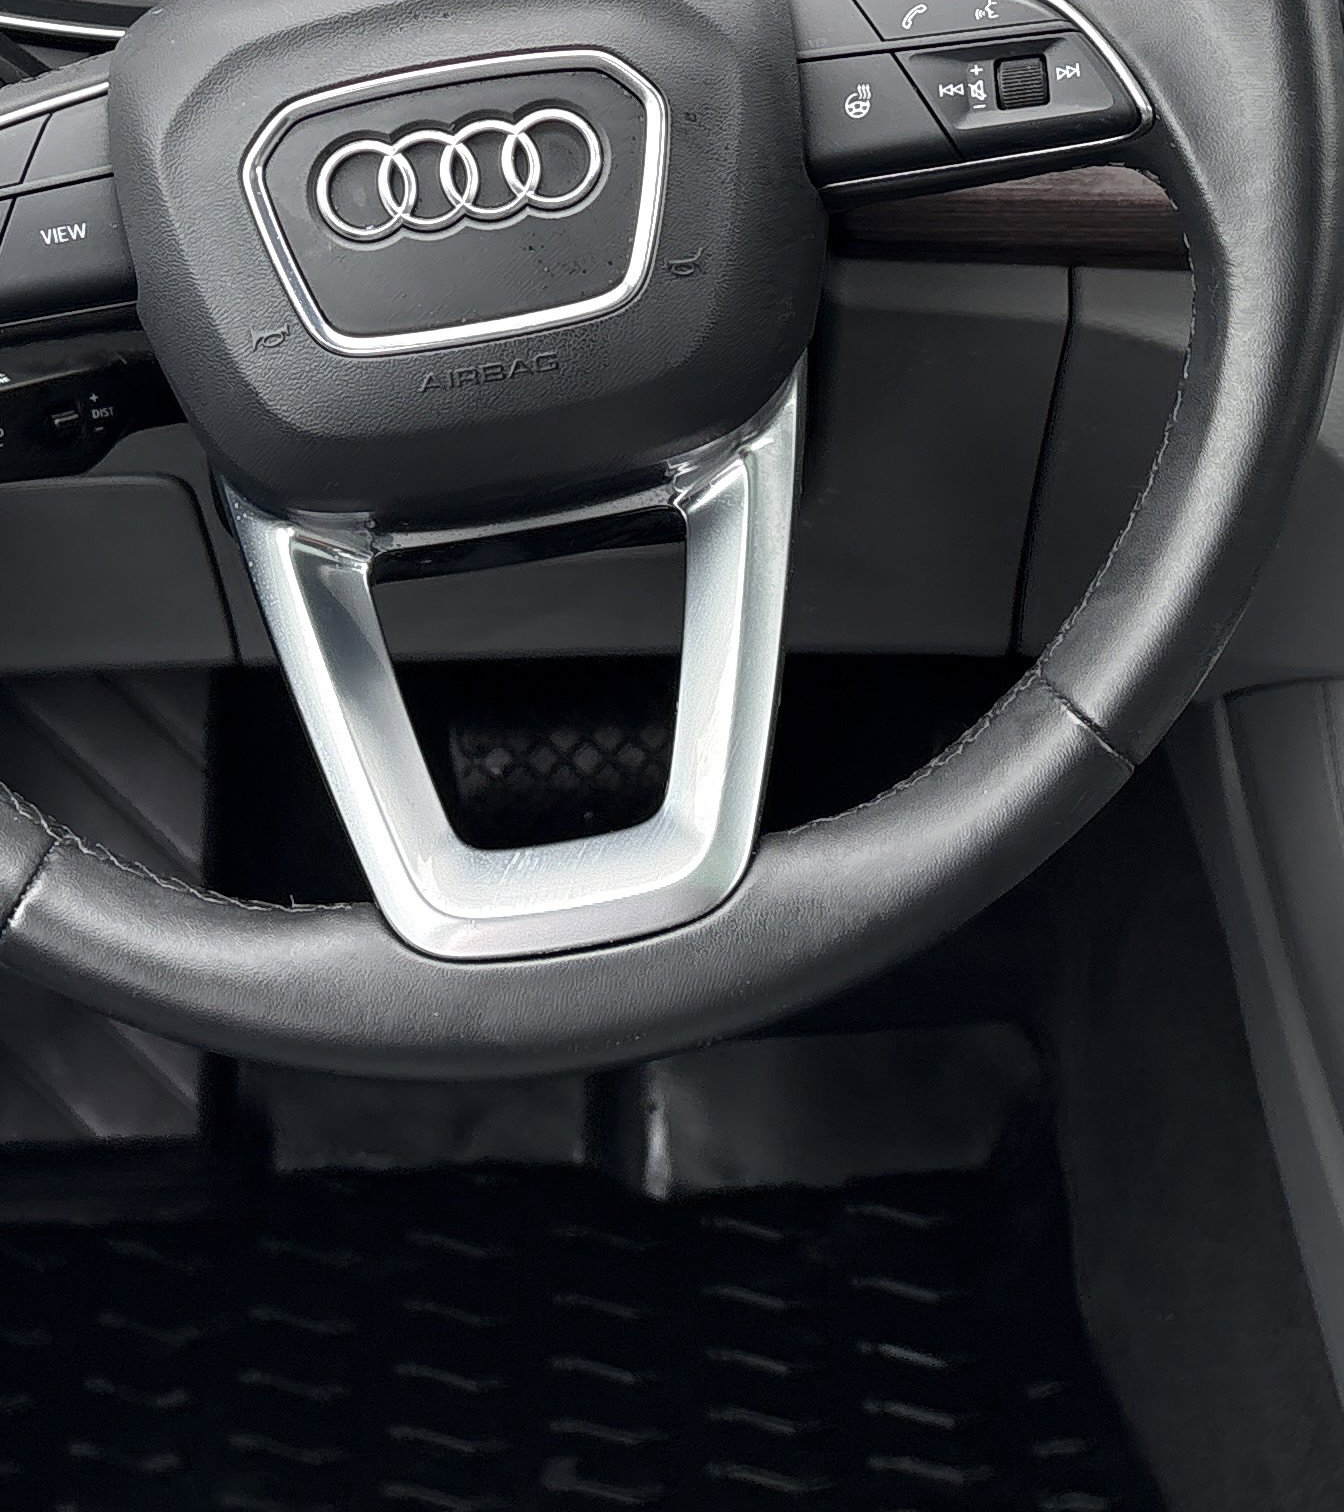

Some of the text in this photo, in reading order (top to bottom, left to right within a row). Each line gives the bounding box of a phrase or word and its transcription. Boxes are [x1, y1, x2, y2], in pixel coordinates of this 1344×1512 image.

[39, 221, 87, 245] VIEW
[420, 353, 561, 392] AIRBAG
[91, 407, 114, 419] DIST
